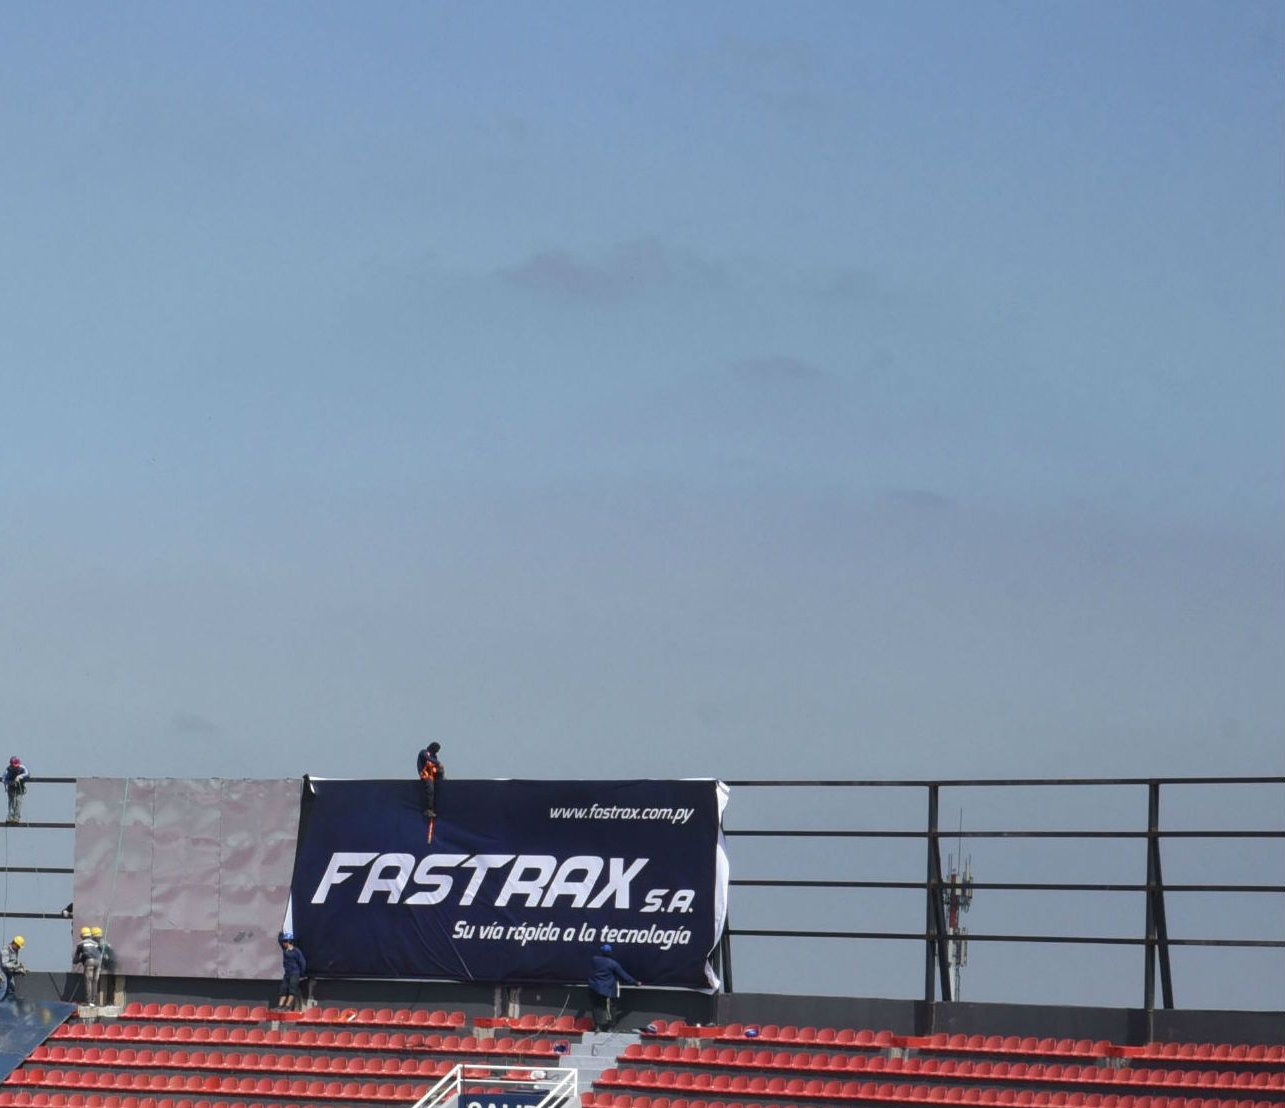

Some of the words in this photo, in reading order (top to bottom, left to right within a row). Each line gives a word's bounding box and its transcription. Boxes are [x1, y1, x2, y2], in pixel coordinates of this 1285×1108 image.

[549, 803, 694, 824] www.fastrax.com.py
[311, 852, 650, 910] FASTRAX
[639, 889, 696, 913] S.A.
[452, 920, 475, 939] Su
[479, 921, 503, 940] vía
[506, 921, 560, 946] rápida
[563, 927, 575, 942] a
[579, 922, 594, 942] la
[601, 925, 691, 950] tecnología
